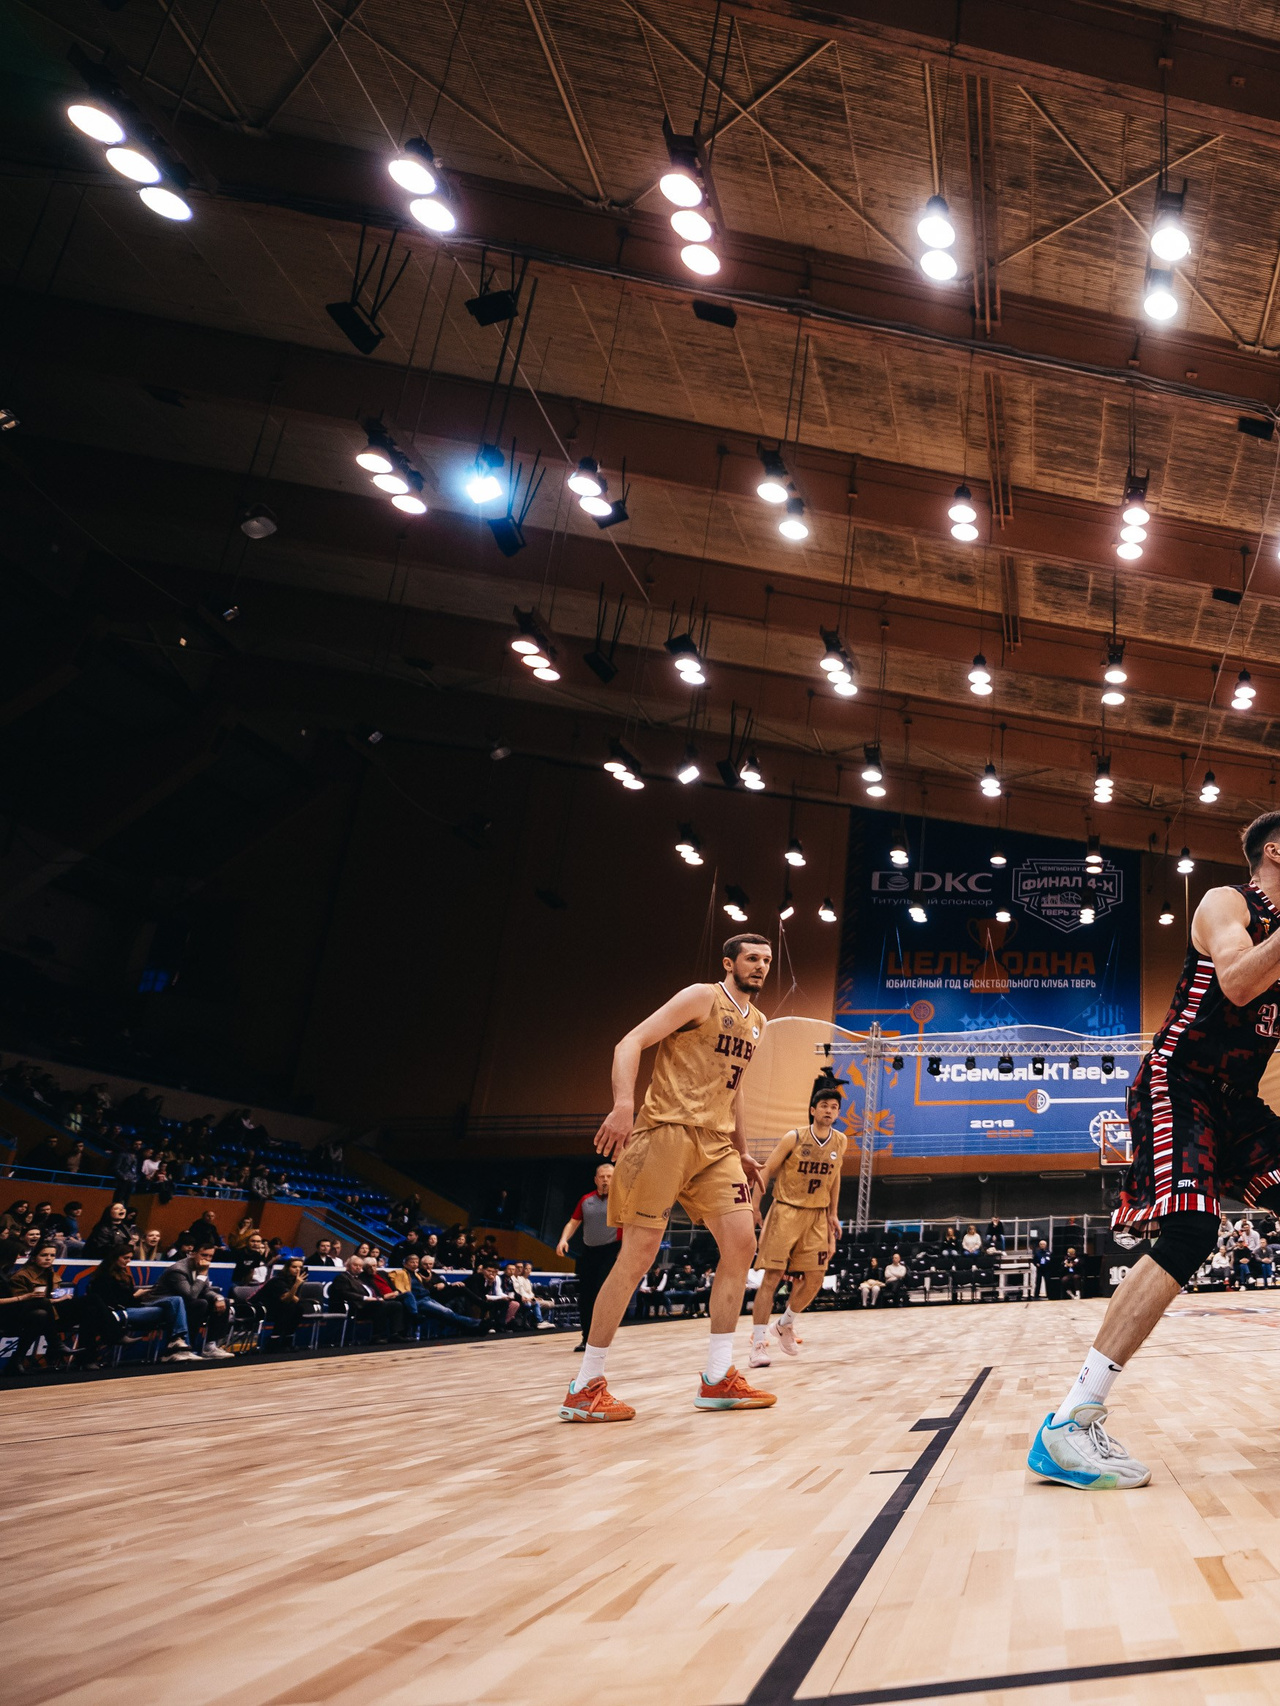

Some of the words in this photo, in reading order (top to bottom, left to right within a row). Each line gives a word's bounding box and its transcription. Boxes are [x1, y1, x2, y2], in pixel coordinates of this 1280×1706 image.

[913, 872, 993, 892] DKC
[1022, 876, 1082, 890] ФИНАЛ
[872, 896, 938, 906] Титульй
[941, 898, 993, 907] спонсор
[887, 952, 980, 976] ЦЕЛЬ
[1001, 952, 1096, 978] ОДНА
[886, 978, 942, 989] ЮБИЛЕЙНЫЙ
[945, 979, 961, 989] ГОД
[963, 979, 1039, 989] БАСКЕТБОЛЬНОГО
[1041, 979, 1068, 989] КЛУБА
[1070, 979, 1096, 989] ТВЕРЬ
[714, 1034, 756, 1063] ЦИВ
[1177, 1179, 1198, 1188] STK
[732, 1183, 751, 1204] 31
